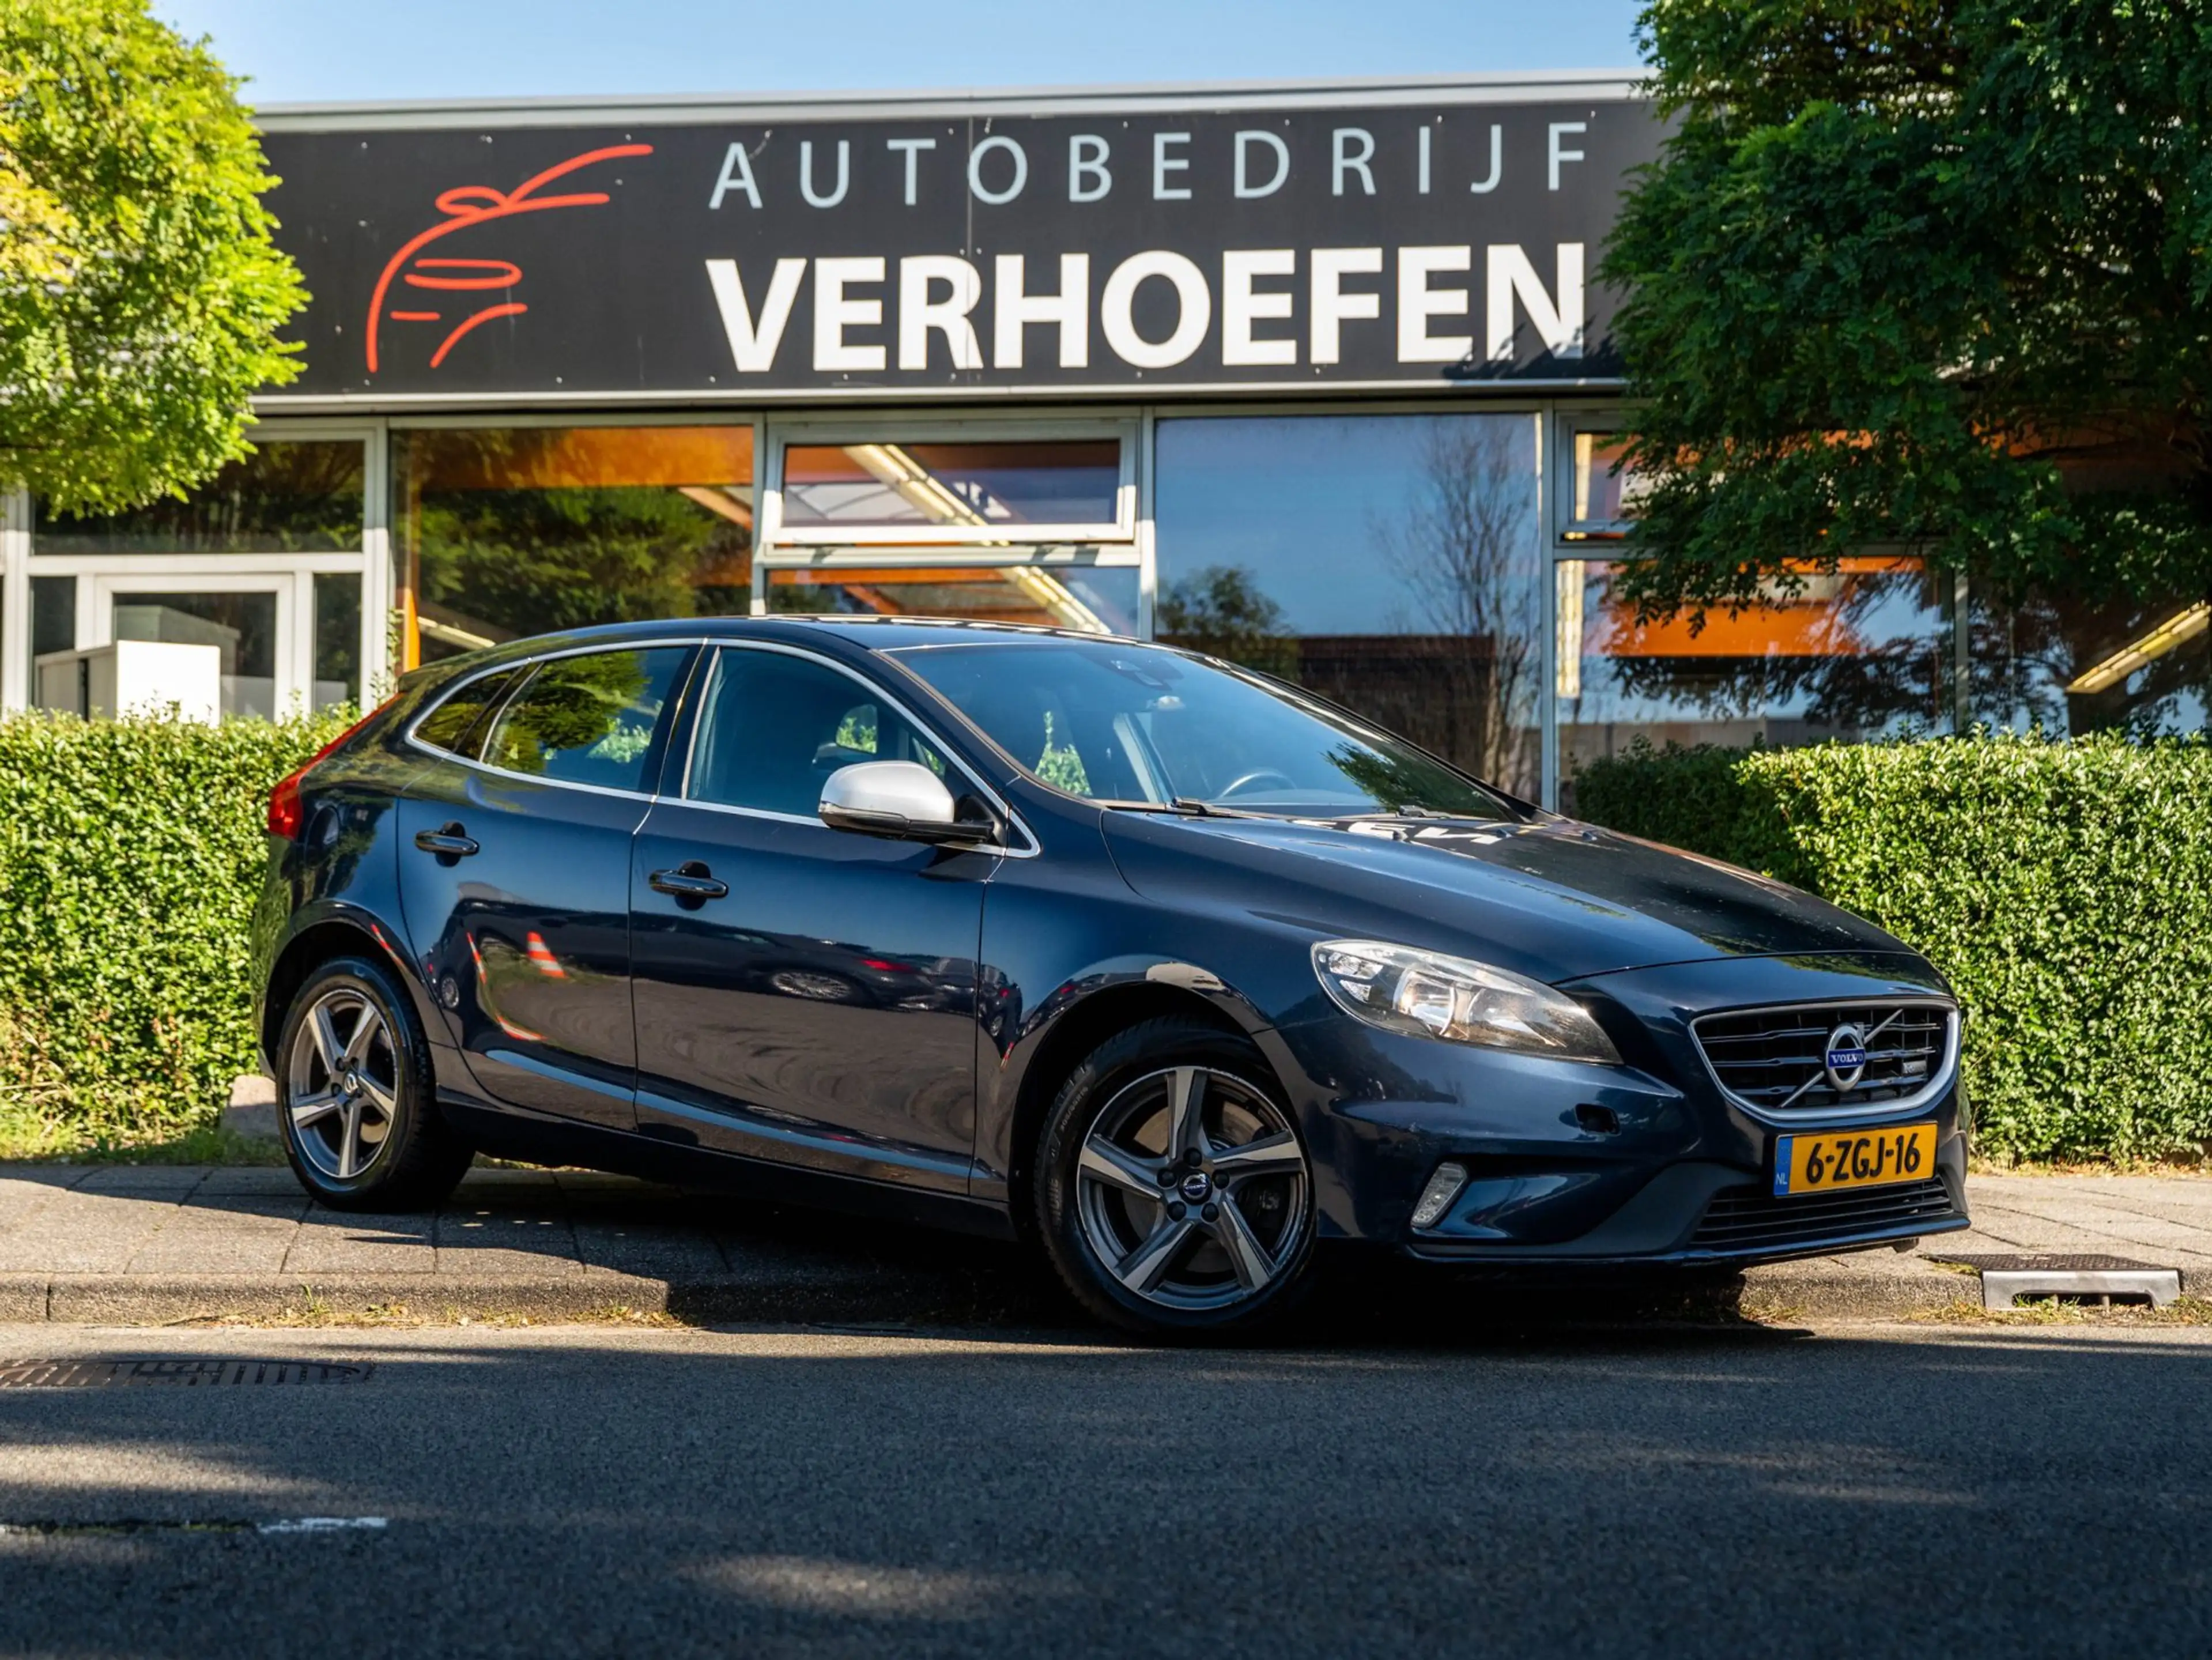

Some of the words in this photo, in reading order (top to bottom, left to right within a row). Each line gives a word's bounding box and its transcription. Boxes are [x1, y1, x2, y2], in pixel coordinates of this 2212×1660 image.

[709, 122, 1587, 209] AUTOBEDRIJF
[705, 242, 1584, 372] VERHOEFEN
[1830, 1053, 1863, 1063] VOLVO
[1775, 1172, 1788, 1185] NL
[1806, 1133, 1920, 1184] 6-ZGJ-16
